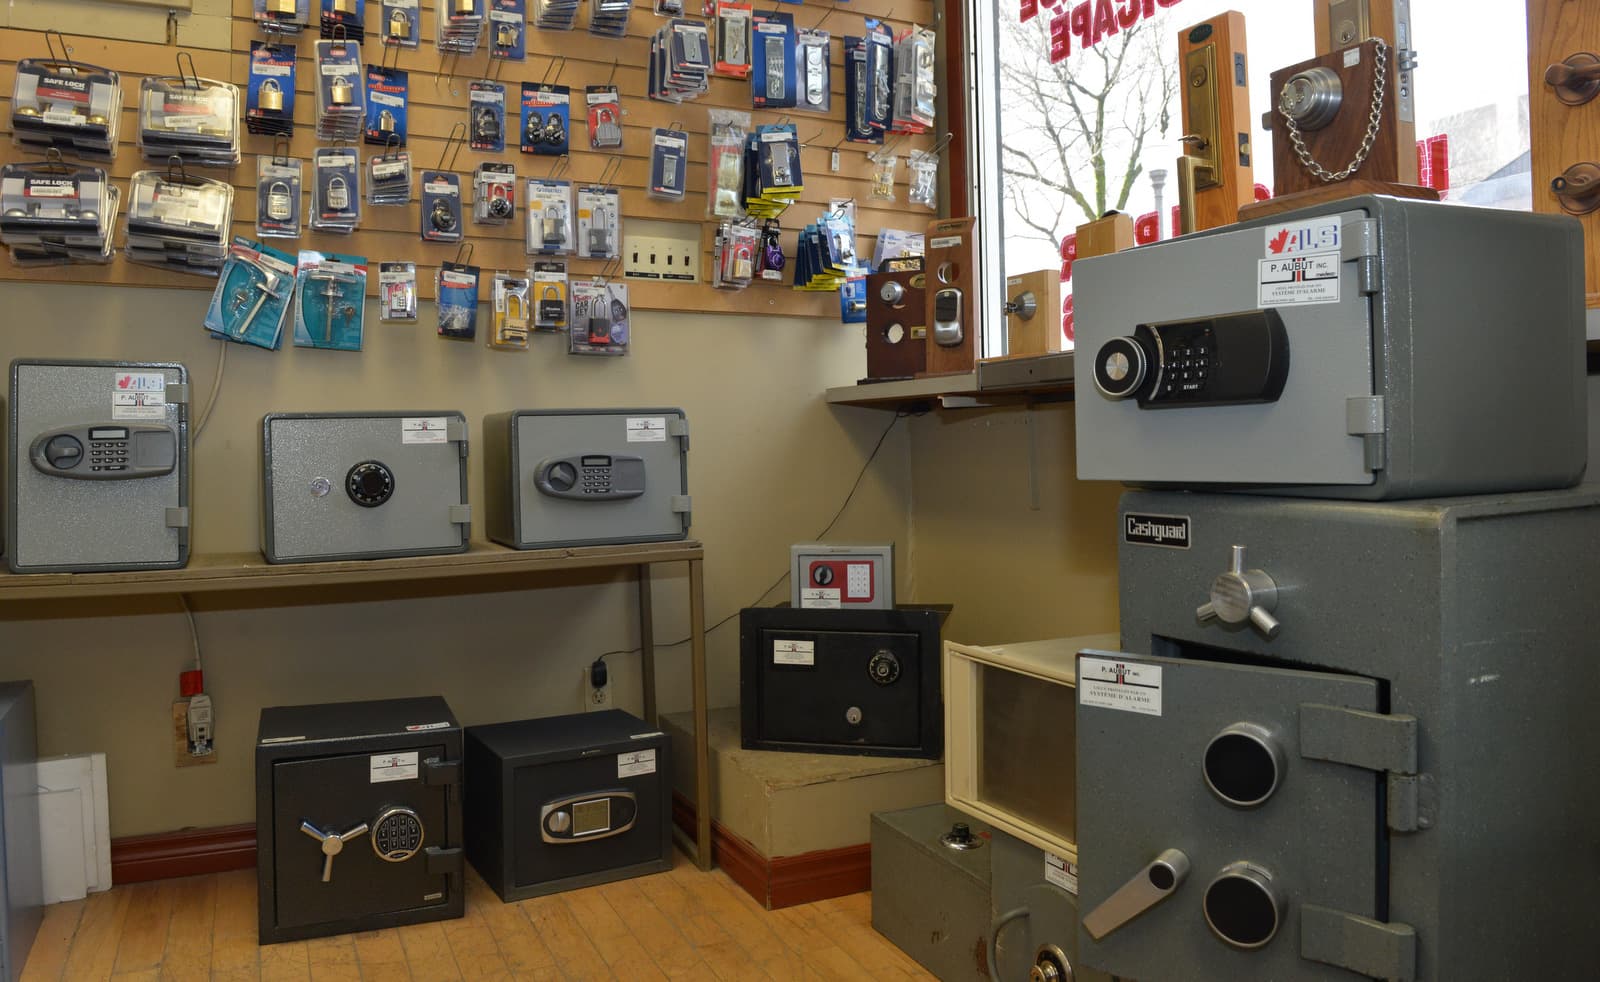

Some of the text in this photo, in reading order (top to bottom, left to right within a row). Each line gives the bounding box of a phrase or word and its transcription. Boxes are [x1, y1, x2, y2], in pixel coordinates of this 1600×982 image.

[43, 78, 86, 89] SAFE LOCK
[1270, 264, 1279, 273] P.
[1281, 260, 1314, 272] AUBUT
[1128, 517, 1186, 542] Cashguard
[1108, 666, 1131, 676] AUBUT
